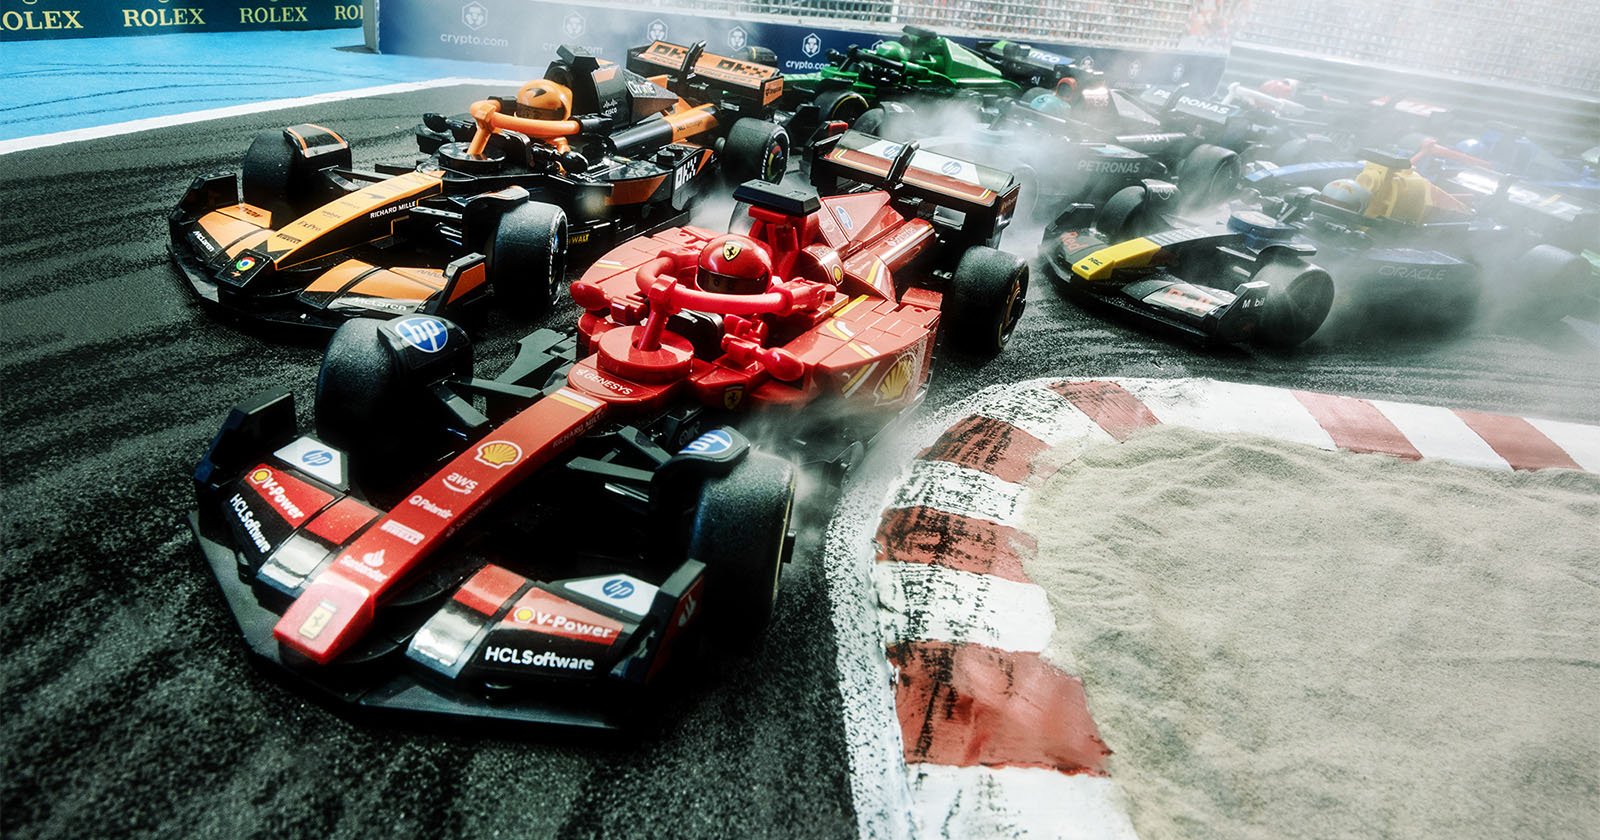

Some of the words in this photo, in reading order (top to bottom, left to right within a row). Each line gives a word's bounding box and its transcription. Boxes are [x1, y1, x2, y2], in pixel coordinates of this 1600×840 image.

[0, 11, 84, 30] OLEX
[123, 9, 206, 27] ROLEX
[239, 7, 308, 24] ROLEX
[440, 32, 508, 47] crypto.com
[1078, 160, 1141, 173] PETRONAS
[369, 206, 397, 219] RICHARD
[398, 200, 417, 211] MILLE
[569, 233, 590, 244] WALT
[1378, 264, 1447, 281] ORACLE
[352, 296, 408, 312] McLaren
[401, 318, 444, 353] hp
[584, 371, 633, 395] GENESYS
[302, 450, 333, 466] hp
[446, 472, 478, 490] aws
[261, 477, 305, 519] V-Power
[229, 493, 272, 554] HCLSoftware
[603, 579, 634, 599] hp
[534, 611, 613, 639] V-Power
[484, 646, 595, 671] HCLSoftware
